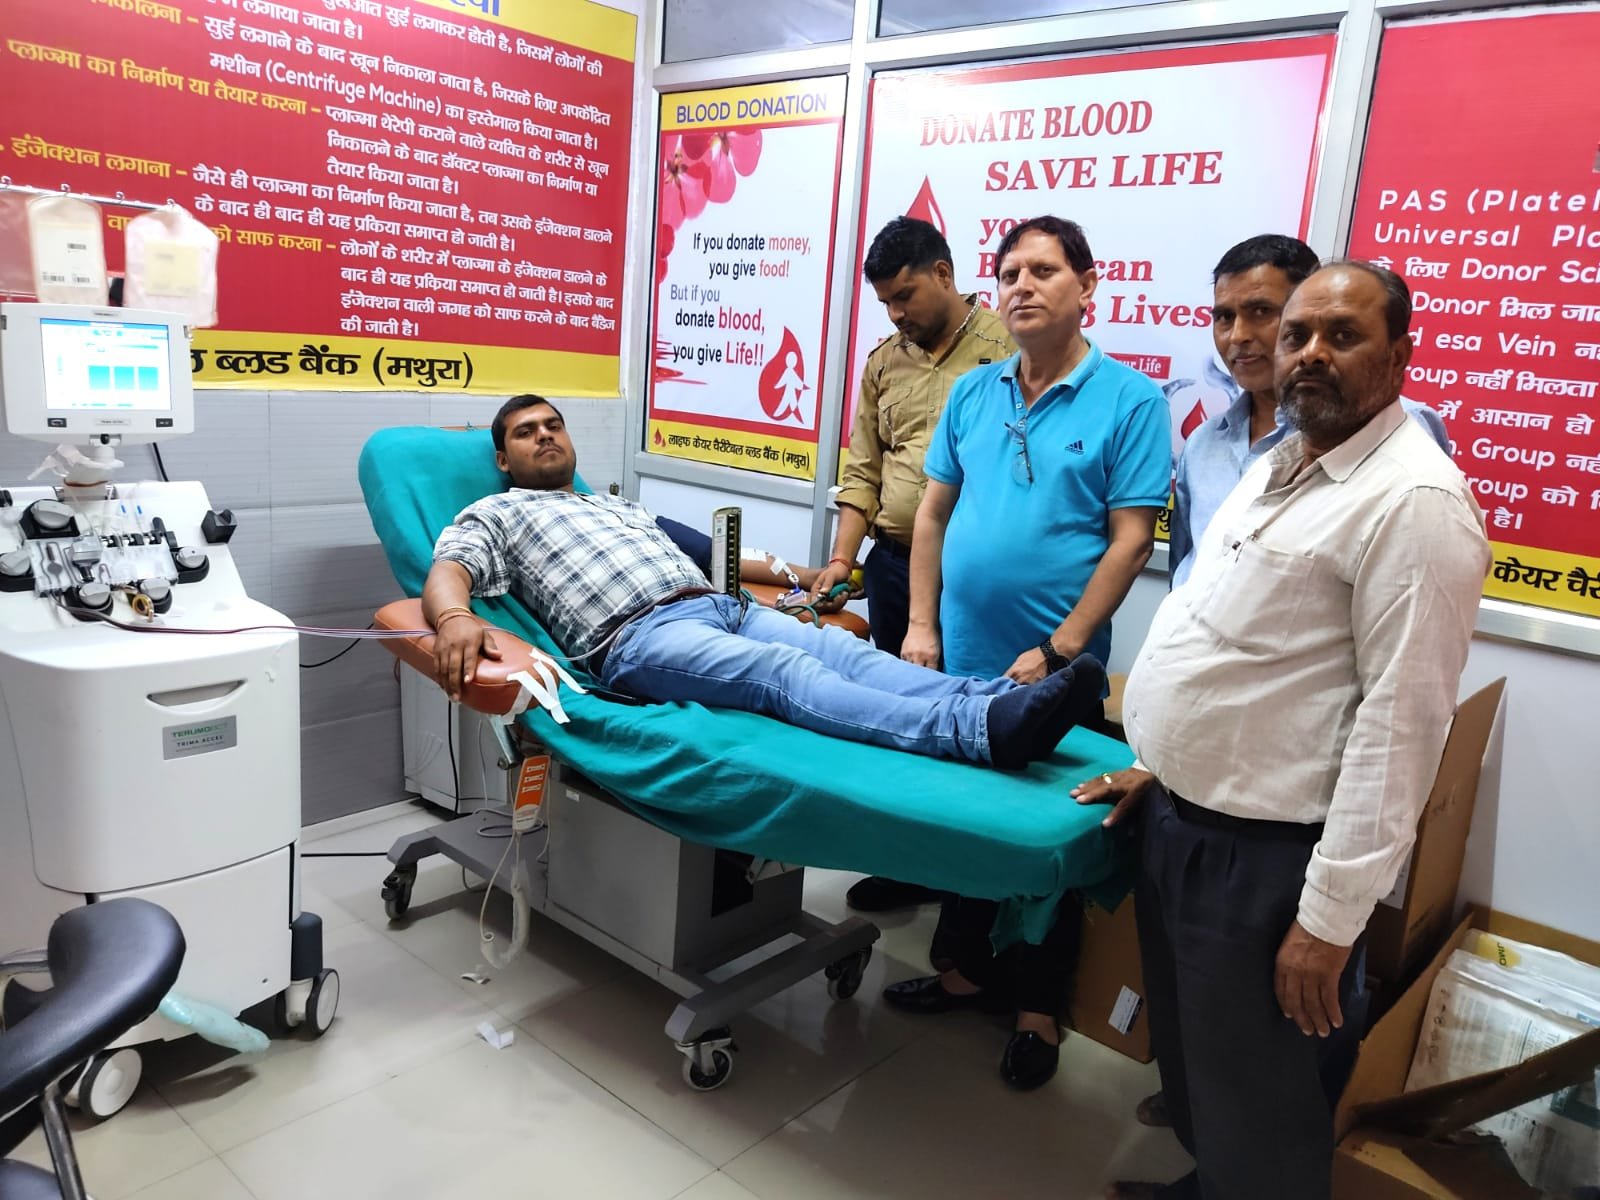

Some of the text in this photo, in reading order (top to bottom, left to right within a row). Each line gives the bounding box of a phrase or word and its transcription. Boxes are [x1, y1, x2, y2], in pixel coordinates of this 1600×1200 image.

[386, 6, 410, 27] सुई
[468, 27, 496, 47] होती
[499, 34, 512, 53] है,
[587, 60, 602, 76] की
[8, 40, 306, 114] प्लाज्मा का निर्माण तैयार करना
[204, 16, 235, 39] सुई
[240, 25, 291, 50] लगाने
[318, 44, 346, 63] बाद
[349, 51, 379, 74] खून
[383, 56, 436, 83] निकाला
[474, 77, 487, 97] है,
[492, 82, 531, 105] जिसके
[534, 93, 558, 113] लिए
[209, 53, 582, 146] मशीन (Centrifuge Machine) का इस्तेमाल जाता
[676, 93, 827, 123] BLOOD DONATION
[920, 100, 1153, 146] DONATE BLOOD
[12, 134, 171, 177] इंजेक्शन लगाना
[326, 105, 609, 179] प्लाज्मा थेरेपी कराने वाले व्यक्ति के शरीर से खून
[327, 129, 598, 196] निकालने बाद डॉक्टर प्लाज्मा निर्माण या
[327, 156, 440, 191] तैयार जाता
[985, 151, 1223, 191] SAVE LIFE
[193, 163, 612, 243] जैसे ही प्लाज्मा का निर्माण जाता है, तब उसके इंजेक्शन डालने
[1379, 189, 1447, 211] PAS
[219, 200, 515, 251] बाद बाद यह समाप्त हो जाती है।
[236, 230, 322, 252] साफ करना
[1374, 223, 1520, 246] Universal
[693, 233, 811, 255] If you donate money,
[340, 239, 593, 285] लोगों शरीर में प्लाज्मा के इंजेक्शन डालने
[709, 259, 790, 281] you give food!
[1405, 256, 1547, 282] लिए Donor
[341, 267, 368, 282] बाद
[390, 273, 412, 287] यह
[460, 280, 501, 296] समाप्त
[503, 282, 516, 298] हो
[519, 286, 546, 301] जाती
[549, 287, 561, 303] है।
[565, 292, 593, 306] इसके
[670, 284, 721, 307] But if you
[341, 289, 400, 310] इंजेक्शन
[403, 297, 435, 313] वाली
[438, 302, 472, 317] जगह
[474, 303, 492, 318] को
[494, 308, 522, 320] साफ
[524, 309, 553, 324] करने
[570, 315, 589, 328] बाद
[675, 306, 765, 336] donate blood,
[1108, 294, 1212, 327] Lives
[1411, 291, 1555, 319] Donor मिल
[340, 315, 418, 335] की जाती है।
[673, 341, 764, 366] you give Life!!
[1435, 333, 1482, 351] esa
[1498, 332, 1556, 357] Vein
[215, 349, 293, 374] ब्लड
[298, 344, 360, 376] बैंक
[373, 347, 474, 388] (मथुरा)
[1139, 358, 1161, 374] Life
[1465, 368, 1599, 399] नहीं मिलता
[1470, 406, 1553, 430] आसान
[1565, 413, 1595, 435] हो
[668, 434, 691, 447] लाइफ
[693, 436, 712, 450] केयर
[763, 445, 779, 461] बैंक
[1472, 438, 1555, 471] Group
[1542, 485, 1579, 507] को
[1493, 506, 1523, 530] है।
[1493, 556, 1563, 592] केयर
